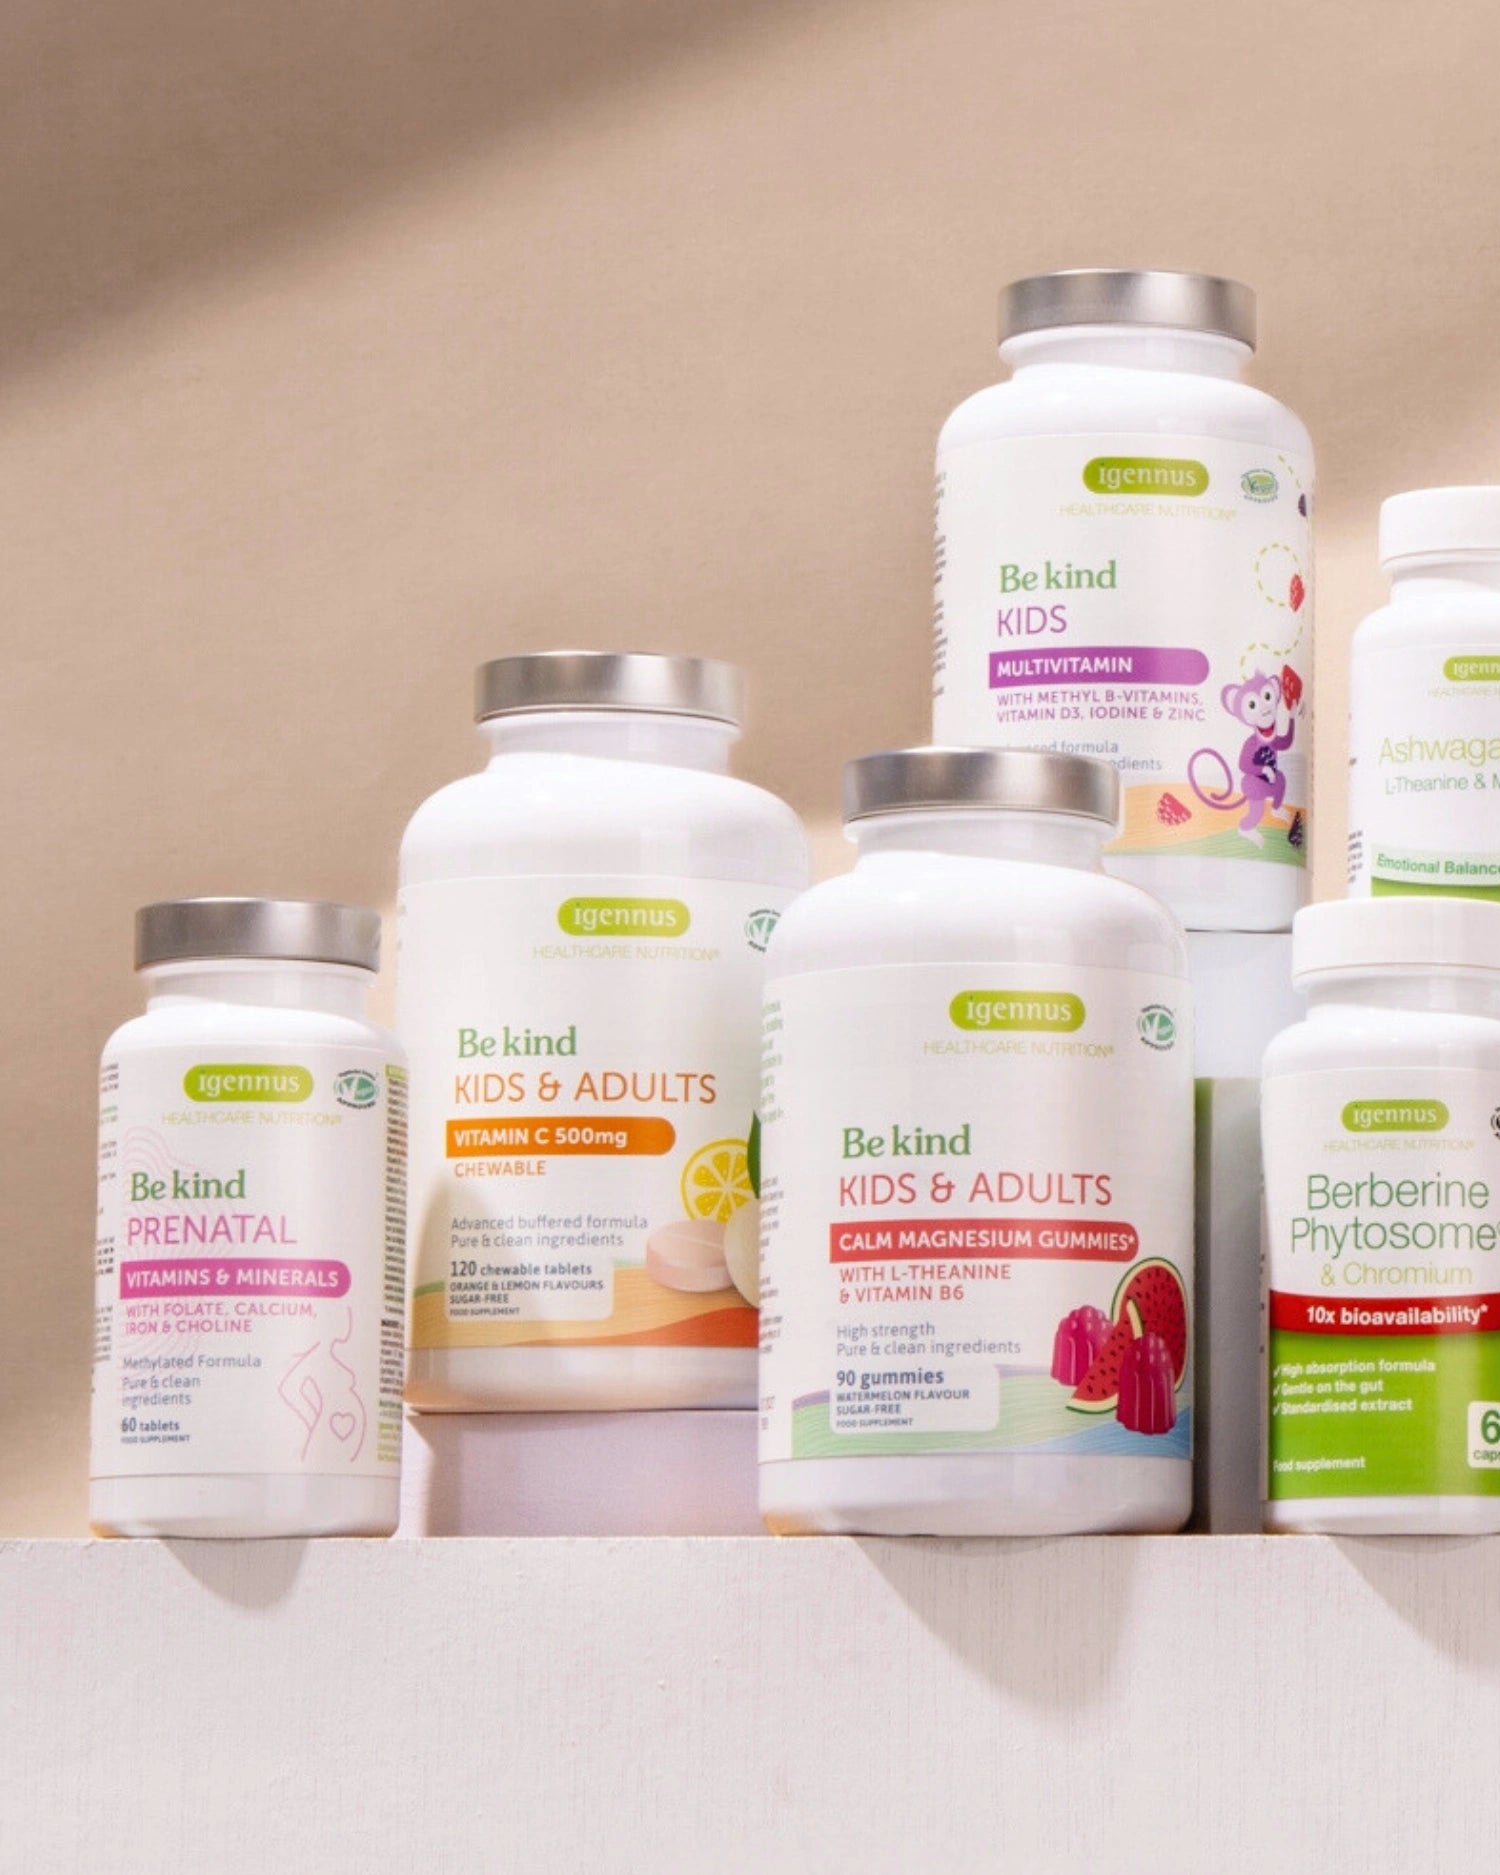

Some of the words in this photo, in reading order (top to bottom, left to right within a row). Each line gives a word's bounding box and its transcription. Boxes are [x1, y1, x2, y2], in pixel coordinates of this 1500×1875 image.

[1000, 564, 1037, 593] Be
[1044, 560, 1117, 590] kind
[998, 606, 1067, 637] KIDS
[998, 657, 1133, 677] MULTIVITAMIN
[997, 692, 1032, 706] WITH
[1037, 690, 1101, 703] METHYL
[997, 708, 1056, 723] VITAMIN
[1089, 707, 1148, 719] IODINE
[1168, 709, 1205, 722] ZINC
[1378, 854, 1440, 874] Emotional
[574, 902, 677, 931] igennus
[966, 996, 1072, 1025] igennus
[458, 1028, 496, 1059] Be
[502, 1025, 578, 1057] kind
[198, 1069, 300, 1098] igennus
[455, 1072, 526, 1104] KIDS
[574, 1071, 718, 1104] ADULTS
[454, 1128, 529, 1148] VITAMIN
[535, 1128, 549, 1144] C
[554, 1127, 629, 1148] 500mg
[842, 1127, 884, 1159] Be
[892, 1124, 971, 1157] kind
[454, 1160, 547, 1179] CHEWABLE
[131, 1172, 166, 1202] Be
[173, 1169, 246, 1200] kind
[839, 1172, 916, 1208] KIDS
[969, 1171, 1113, 1207] ADULTS
[1308, 1172, 1490, 1211] Berberine
[128, 1214, 298, 1246] PRENATAL
[518, 1214, 582, 1230] buffered
[839, 1234, 892, 1251] CALM
[899, 1230, 1032, 1249] MAGNESIUM
[127, 1268, 210, 1288] VITAMINS
[236, 1268, 339, 1288] MINERALS
[480, 1261, 540, 1276] chewable
[839, 1267, 885, 1283] WITH
[891, 1264, 1012, 1281] L-THEANINE
[1342, 1262, 1472, 1286] Chromium
[856, 1286, 932, 1302] VITAMIN
[939, 1285, 964, 1301] B6
[126, 1304, 159, 1318] WITH
[1306, 1306, 1334, 1324] 10x
[176, 1319, 253, 1334] CHOLINE
[836, 1324, 868, 1342] High
[123, 1355, 194, 1370] Methylated
[198, 1354, 262, 1368] Formula
[1306, 1361, 1374, 1376] absorption
[1379, 1358, 1436, 1372] formula
[836, 1370, 856, 1387] 90
[861, 1368, 944, 1390] gummies
[1335, 1380, 1356, 1392] the
[1360, 1380, 1384, 1394] gut
[914, 1389, 970, 1401] FLAVOUR
[1360, 1398, 1413, 1412] extract
